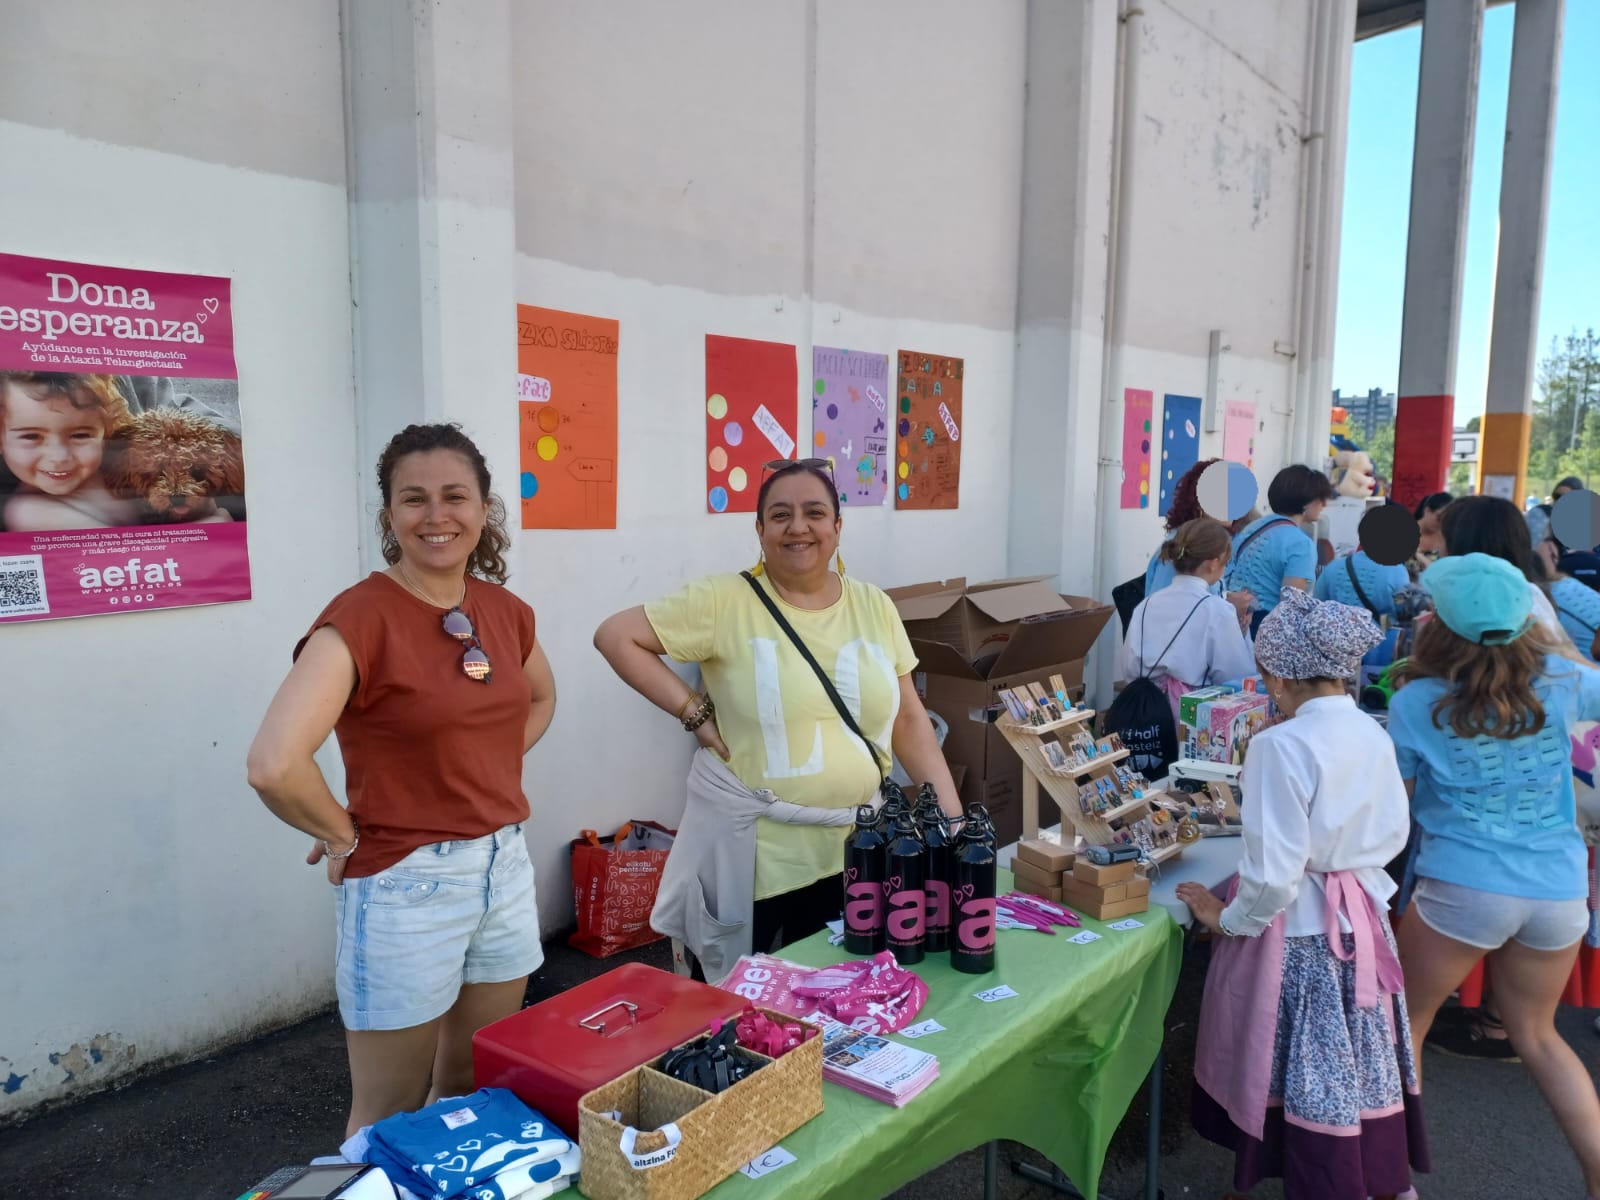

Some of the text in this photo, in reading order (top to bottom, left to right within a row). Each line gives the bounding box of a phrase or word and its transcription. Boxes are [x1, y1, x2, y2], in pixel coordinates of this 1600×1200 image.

[46, 272, 156, 310] Dona
[0, 305, 204, 344] esperanza
[22, 341, 84, 353] Ayúdanos
[102, 347, 114, 355] la
[115, 348, 187, 360] investigación
[31, 353, 184, 369] de la Ataxia Telangiectasia
[47, 542, 81, 550] provoca
[98, 540, 121, 548] grave
[122, 537, 170, 545] discapacidad
[170, 535, 209, 543] progresiva
[51, 533, 99, 542] enfermedad
[161, 528, 207, 536] tratamiento,
[106, 546, 130, 554] riesgo
[79, 558, 181, 589] aefat
[81, 582, 182, 595] www.aefat.es
[1125, 741, 1161, 751] asteiz
[887, 890, 925, 940] a
[958, 898, 997, 950] a
